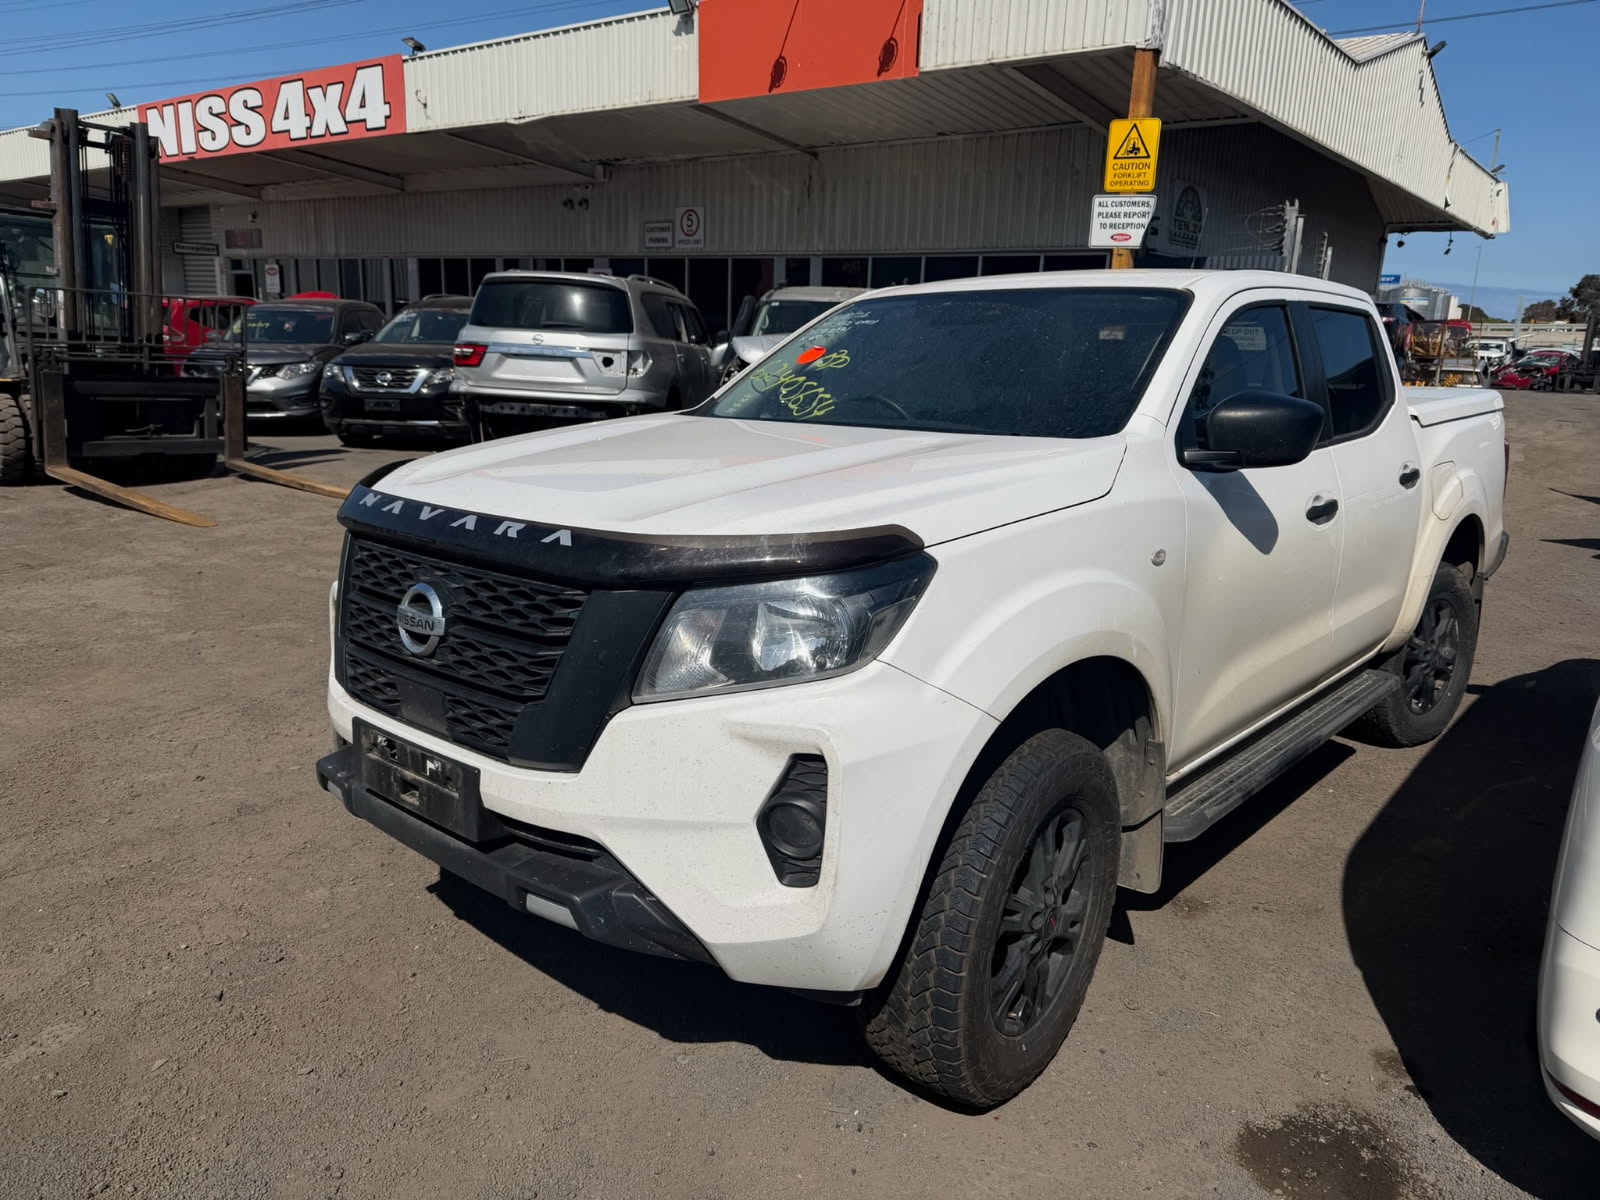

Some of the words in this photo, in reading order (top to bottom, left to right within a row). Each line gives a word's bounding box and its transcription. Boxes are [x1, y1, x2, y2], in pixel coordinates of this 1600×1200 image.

[146, 87, 266, 158] NISS
[271, 64, 391, 140] 4x4
[1112, 162, 1151, 171] CAUTION
[1098, 200, 1109, 208] ALL
[1110, 200, 1152, 208] CUSTOMERS,
[1097, 211, 1122, 219] PLEASE
[1123, 211, 1151, 219] REPORT
[686, 213, 694, 228] 5
[1099, 222, 1108, 230] TO
[1108, 222, 1146, 230] RECEPTION
[359, 492, 572, 547] NAVARA
